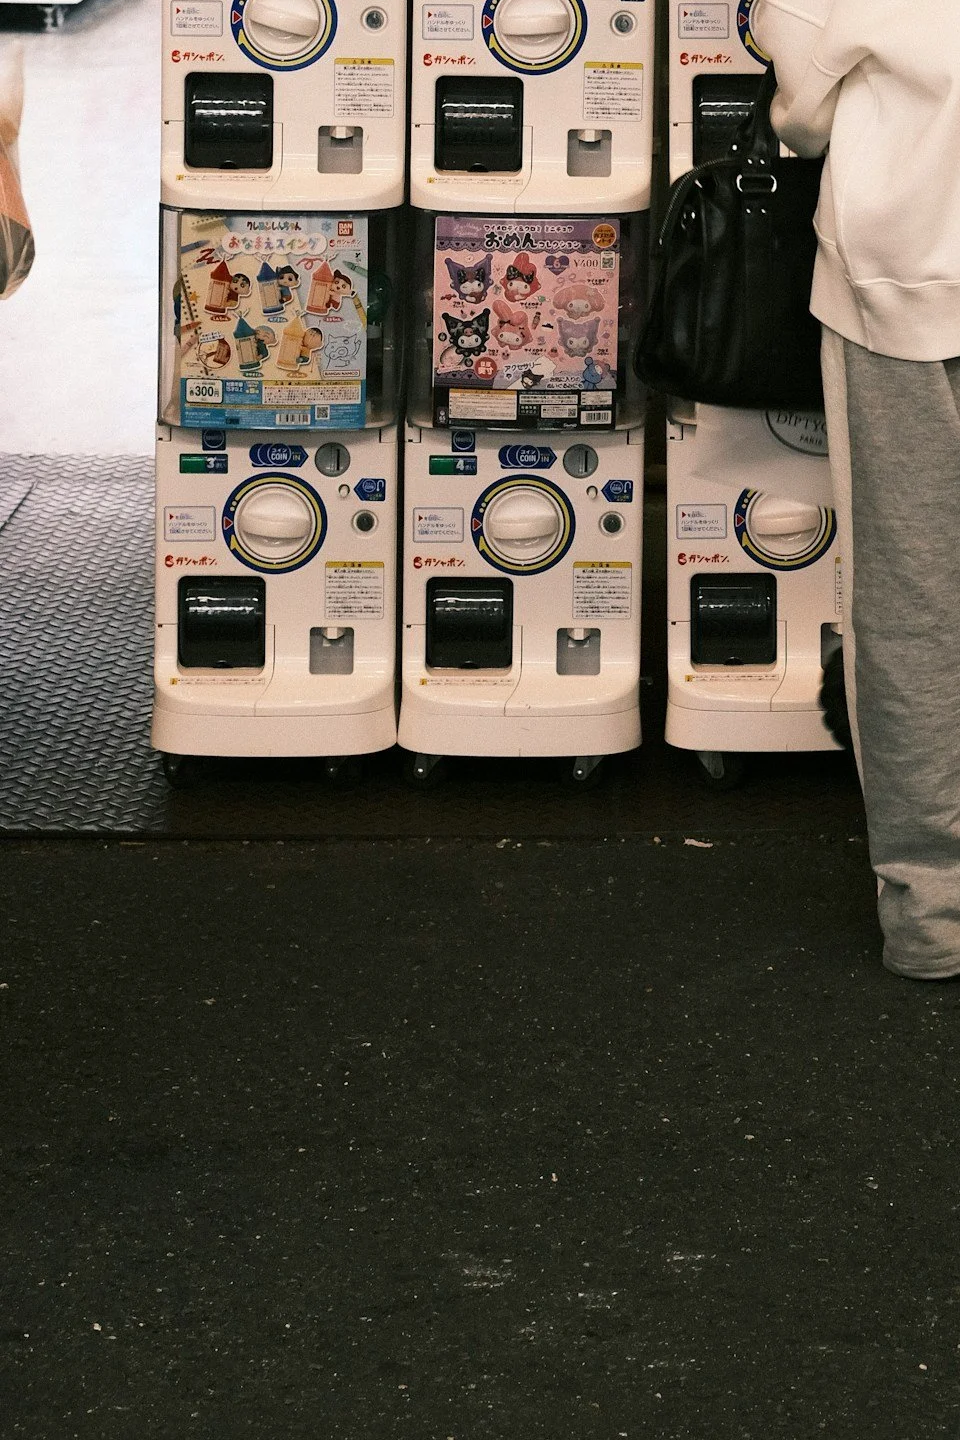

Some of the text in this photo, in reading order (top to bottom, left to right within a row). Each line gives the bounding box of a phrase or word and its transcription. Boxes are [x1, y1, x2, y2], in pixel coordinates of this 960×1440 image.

[228, 236, 321, 250] おなまえスイング
[271, 452, 288, 460] COIN
[519, 454, 537, 462] COIN
